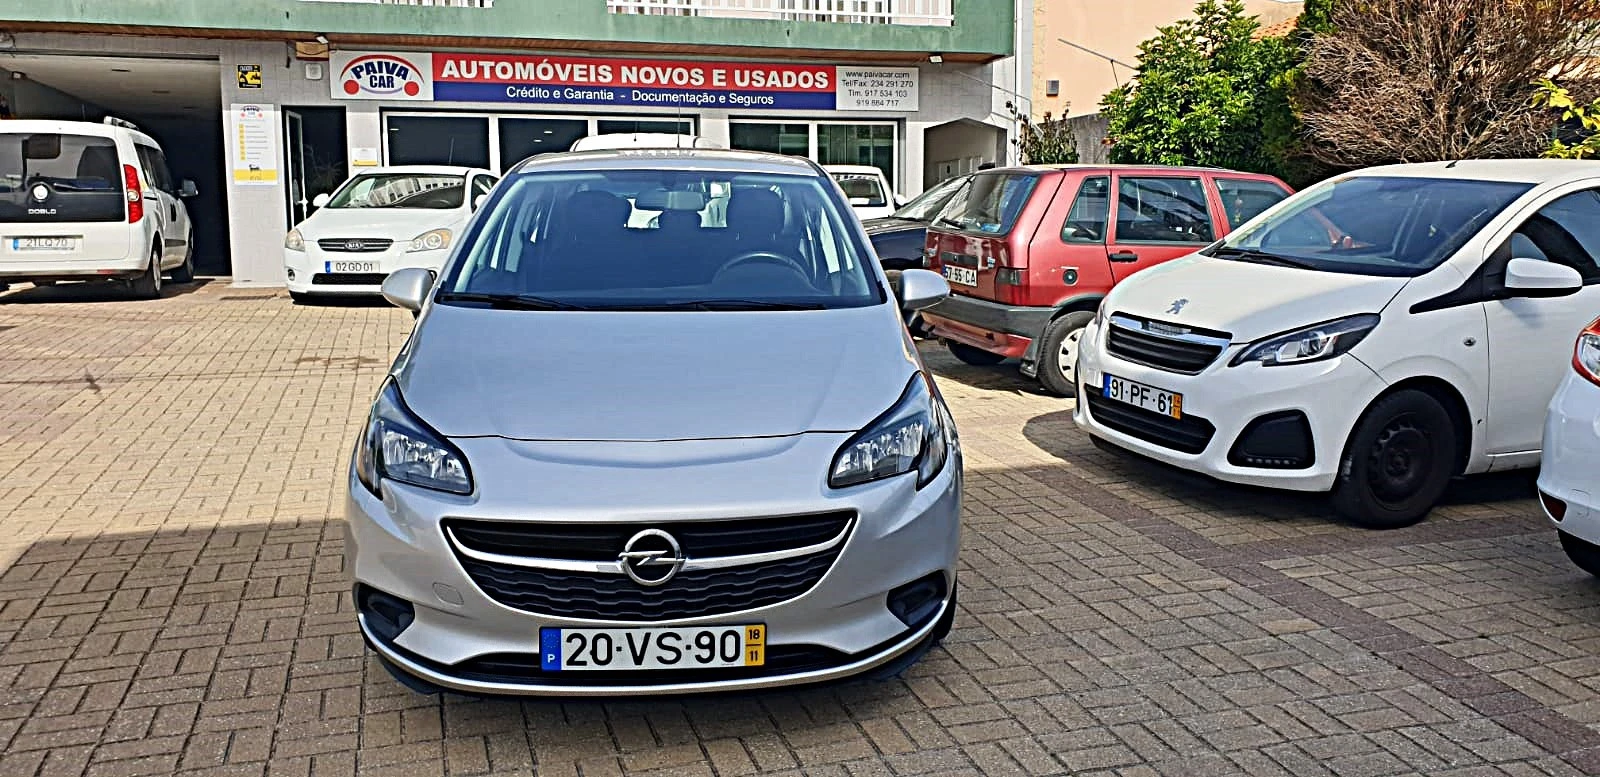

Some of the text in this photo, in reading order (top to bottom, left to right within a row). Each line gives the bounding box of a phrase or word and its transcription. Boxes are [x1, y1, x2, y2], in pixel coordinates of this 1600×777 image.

[351, 61, 410, 81] PAIVA
[441, 59, 829, 89] AUTOMÓVEIS NOVOS E USADOS
[369, 75, 395, 89] CAR
[506, 86, 550, 98] Crédito
[553, 90, 560, 98] e
[564, 88, 614, 100] Garantia
[632, 90, 716, 105] Documentação
[719, 95, 726, 103] e
[729, 93, 774, 106] Seguros
[856, 99, 870, 107] 919
[886, 99, 899, 107] 717
[748, 628, 760, 640] 18
[547, 654, 555, 663] P
[749, 650, 759, 662] 11
